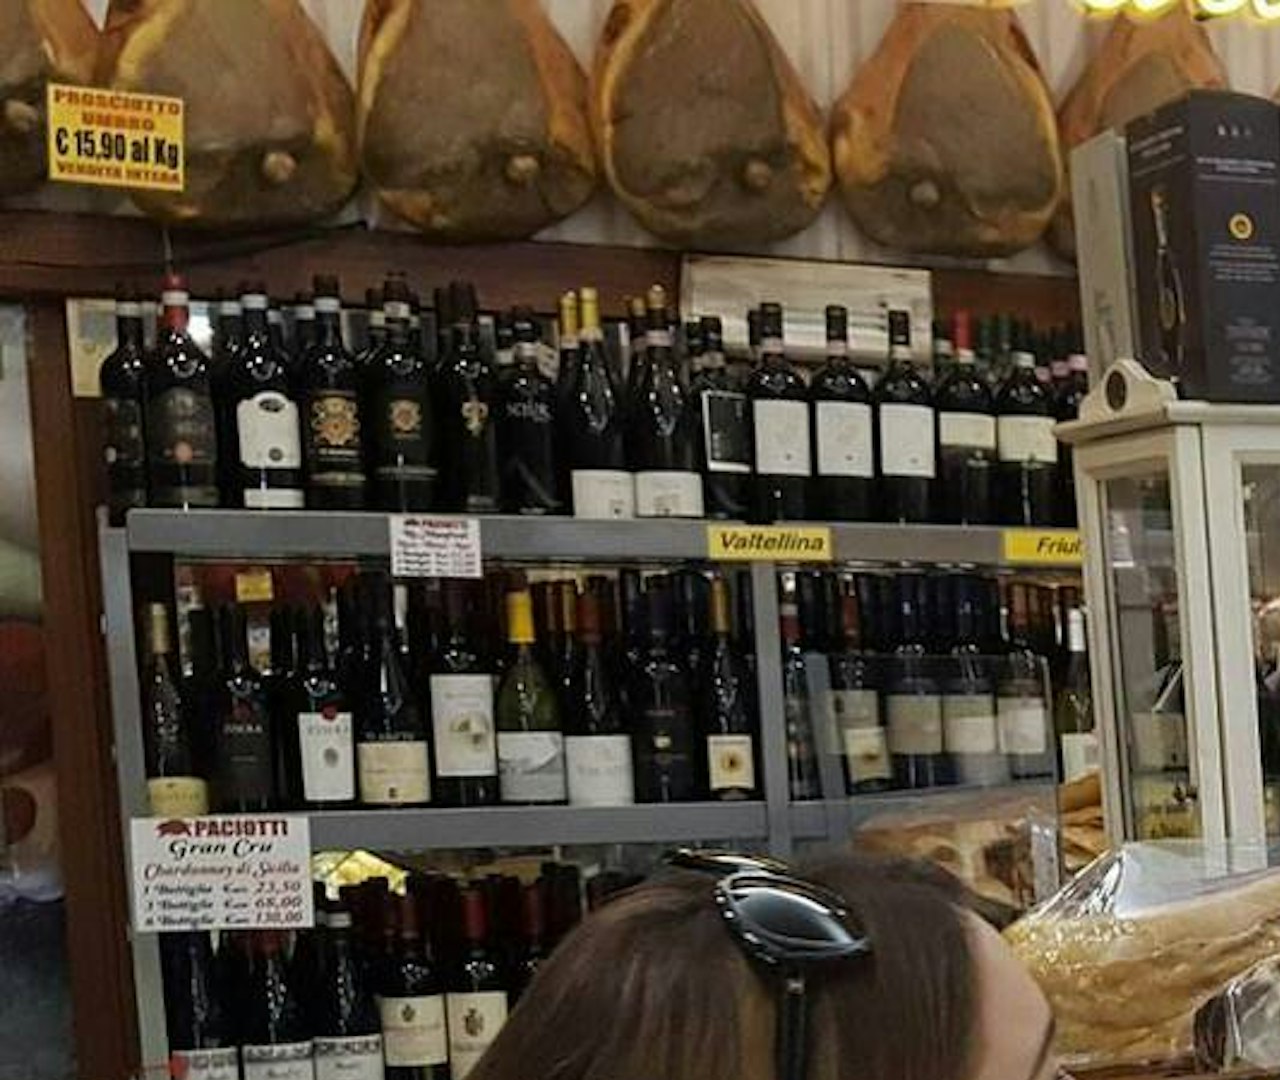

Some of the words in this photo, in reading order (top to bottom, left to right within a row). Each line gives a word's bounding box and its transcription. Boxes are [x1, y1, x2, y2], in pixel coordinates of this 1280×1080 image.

[131, 135, 149, 163] al
[154, 136, 178, 170] Kg
[720, 531, 824, 552] Valtellina
[194, 819, 289, 837] PACIOTTI
[168, 839, 226, 860] Gran
[232, 838, 274, 857] Cru
